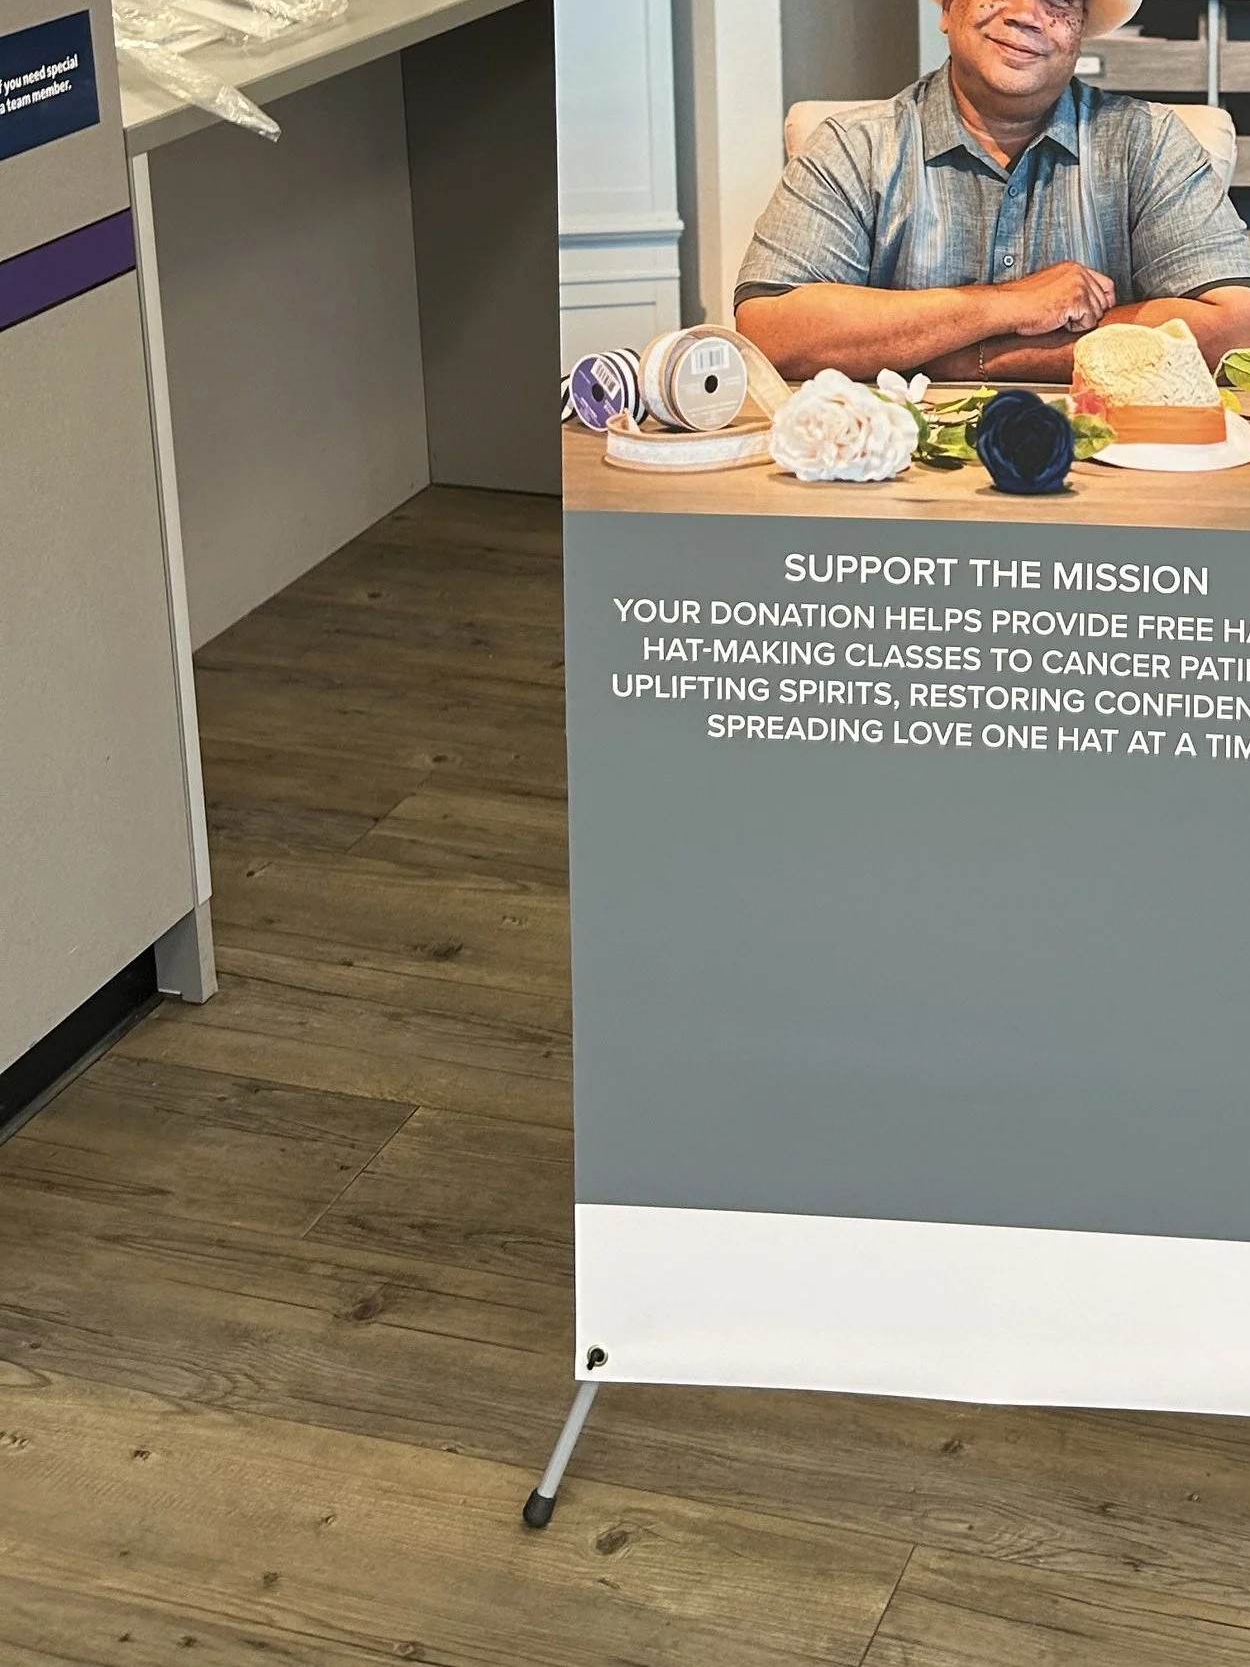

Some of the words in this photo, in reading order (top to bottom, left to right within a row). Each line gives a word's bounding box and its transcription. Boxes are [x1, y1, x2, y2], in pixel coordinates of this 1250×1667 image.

[4, 76, 22, 96] you
[23, 64, 46, 86] need
[47, 53, 78, 79] special
[6, 94, 31, 112] team
[784, 553, 959, 587] SUPPORT
[968, 558, 1041, 589] THE
[1053, 561, 1208, 596] MISSION
[612, 597, 701, 624] YOUR
[710, 600, 875, 631] DONATION
[885, 605, 983, 633] HELPS
[992, 609, 1128, 639] PROVIDE
[1138, 614, 1214, 642] FREE
[643, 636, 836, 667] HAT-MAKING
[844, 642, 982, 671] CLASSES
[989, 647, 1033, 673] TO
[1041, 649, 1171, 679] CANCER
[612, 673, 770, 702] UPLIFTING
[778, 678, 900, 712] SPIRITS,
[909, 682, 1085, 714] RESTORING
[707, 713, 884, 744] SPREADING
[893, 720, 973, 747] LOVE
[981, 723, 1048, 750] ONE
[1057, 726, 1120, 755] HAT
[1126, 730, 1167, 755] AT
[1174, 732, 1198, 757] A
